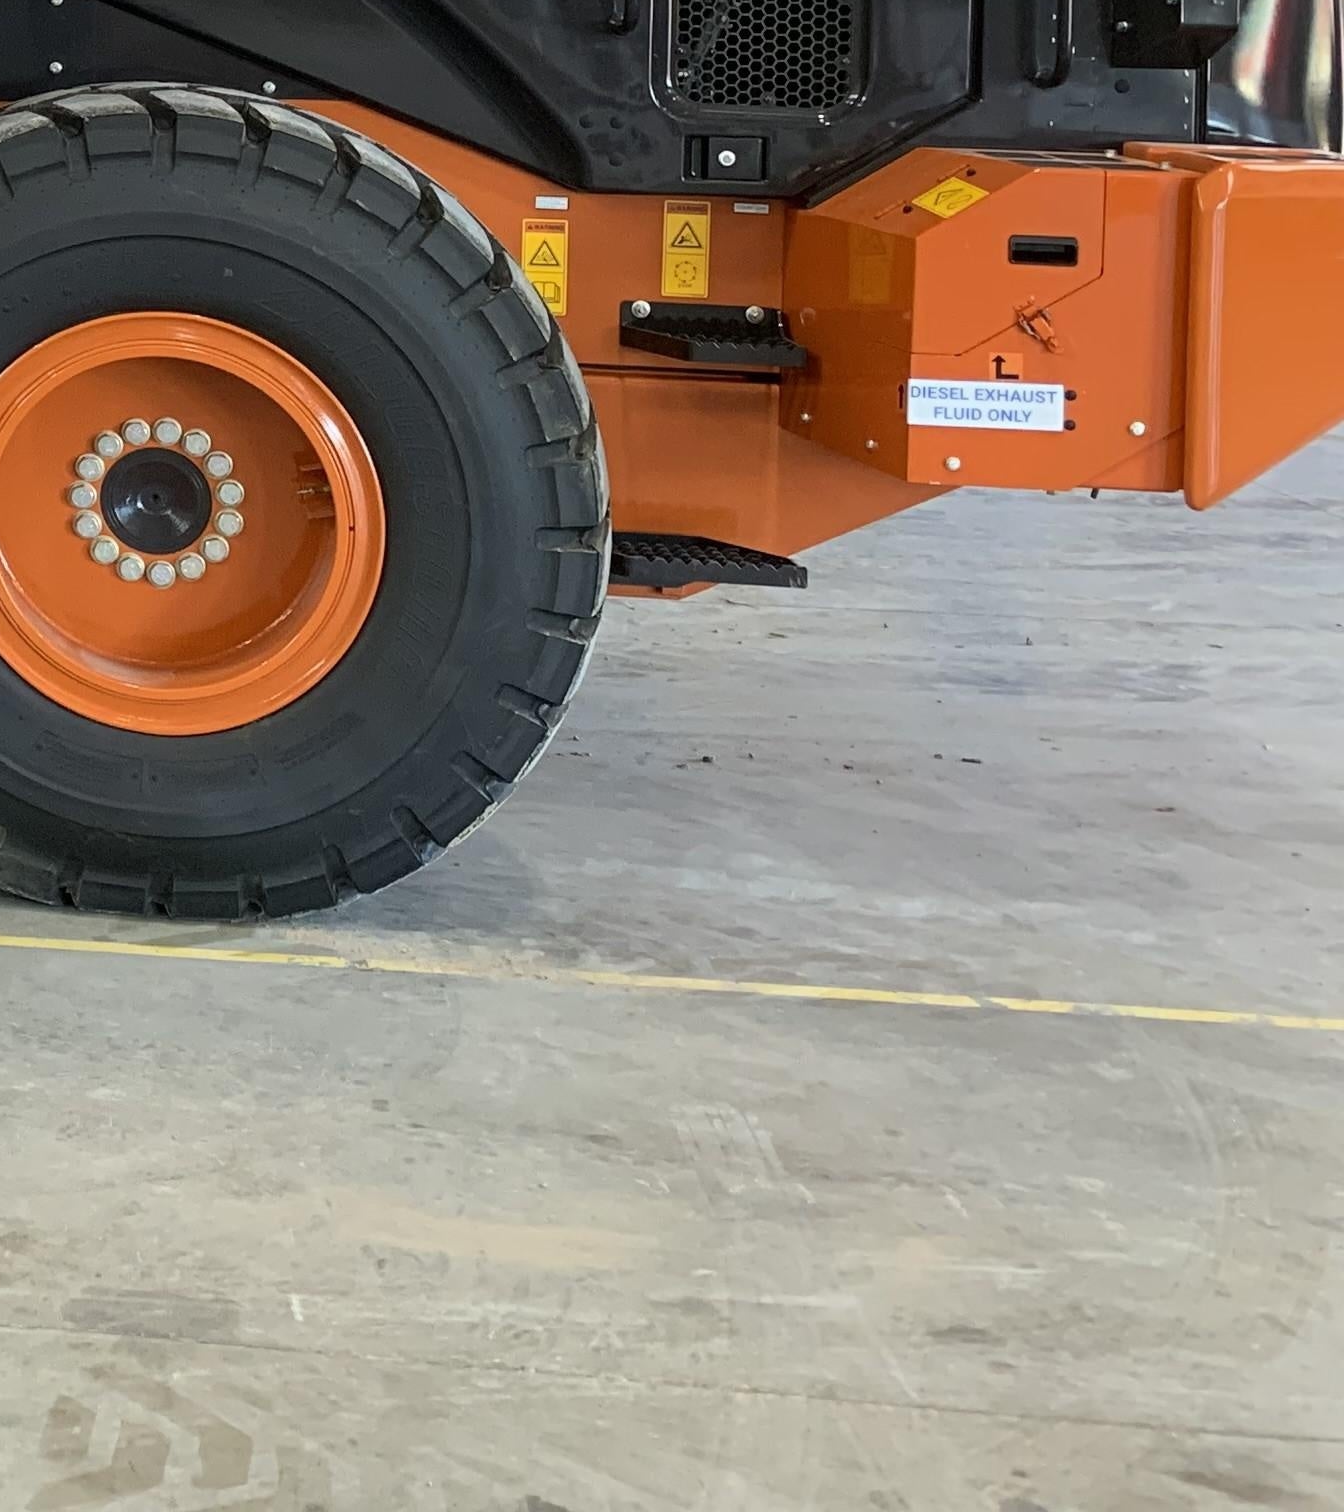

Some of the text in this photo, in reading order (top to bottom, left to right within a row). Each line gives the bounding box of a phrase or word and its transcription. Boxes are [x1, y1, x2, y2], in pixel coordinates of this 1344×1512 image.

[911, 385, 1058, 404] DIESEL EXHAUST
[933, 406, 1033, 423] FLUID ONLY
